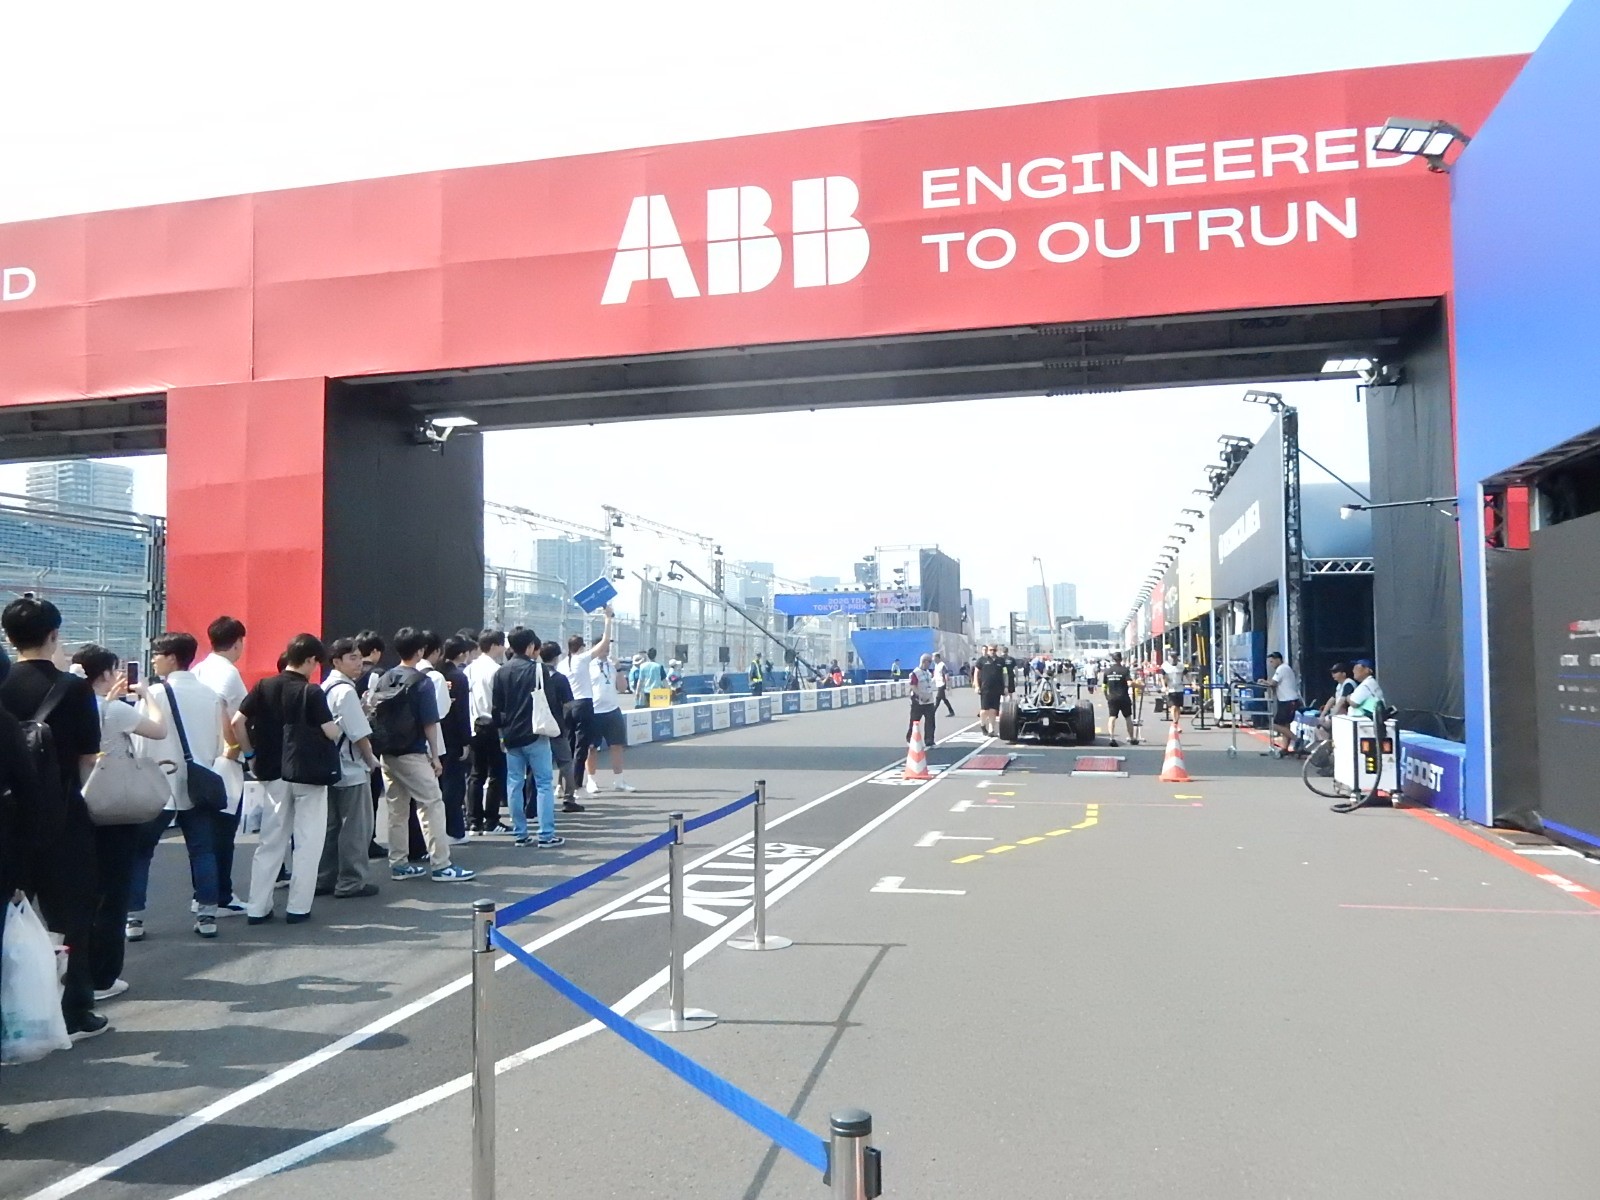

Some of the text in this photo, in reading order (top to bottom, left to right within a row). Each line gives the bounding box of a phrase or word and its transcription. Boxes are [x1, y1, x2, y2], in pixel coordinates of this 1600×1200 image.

[922, 126, 1416, 209] ENGINEERED
[601, 175, 870, 305] ABB
[922, 197, 1358, 273] TO OUTRUN
[1405, 756, 1444, 793] BOOST
